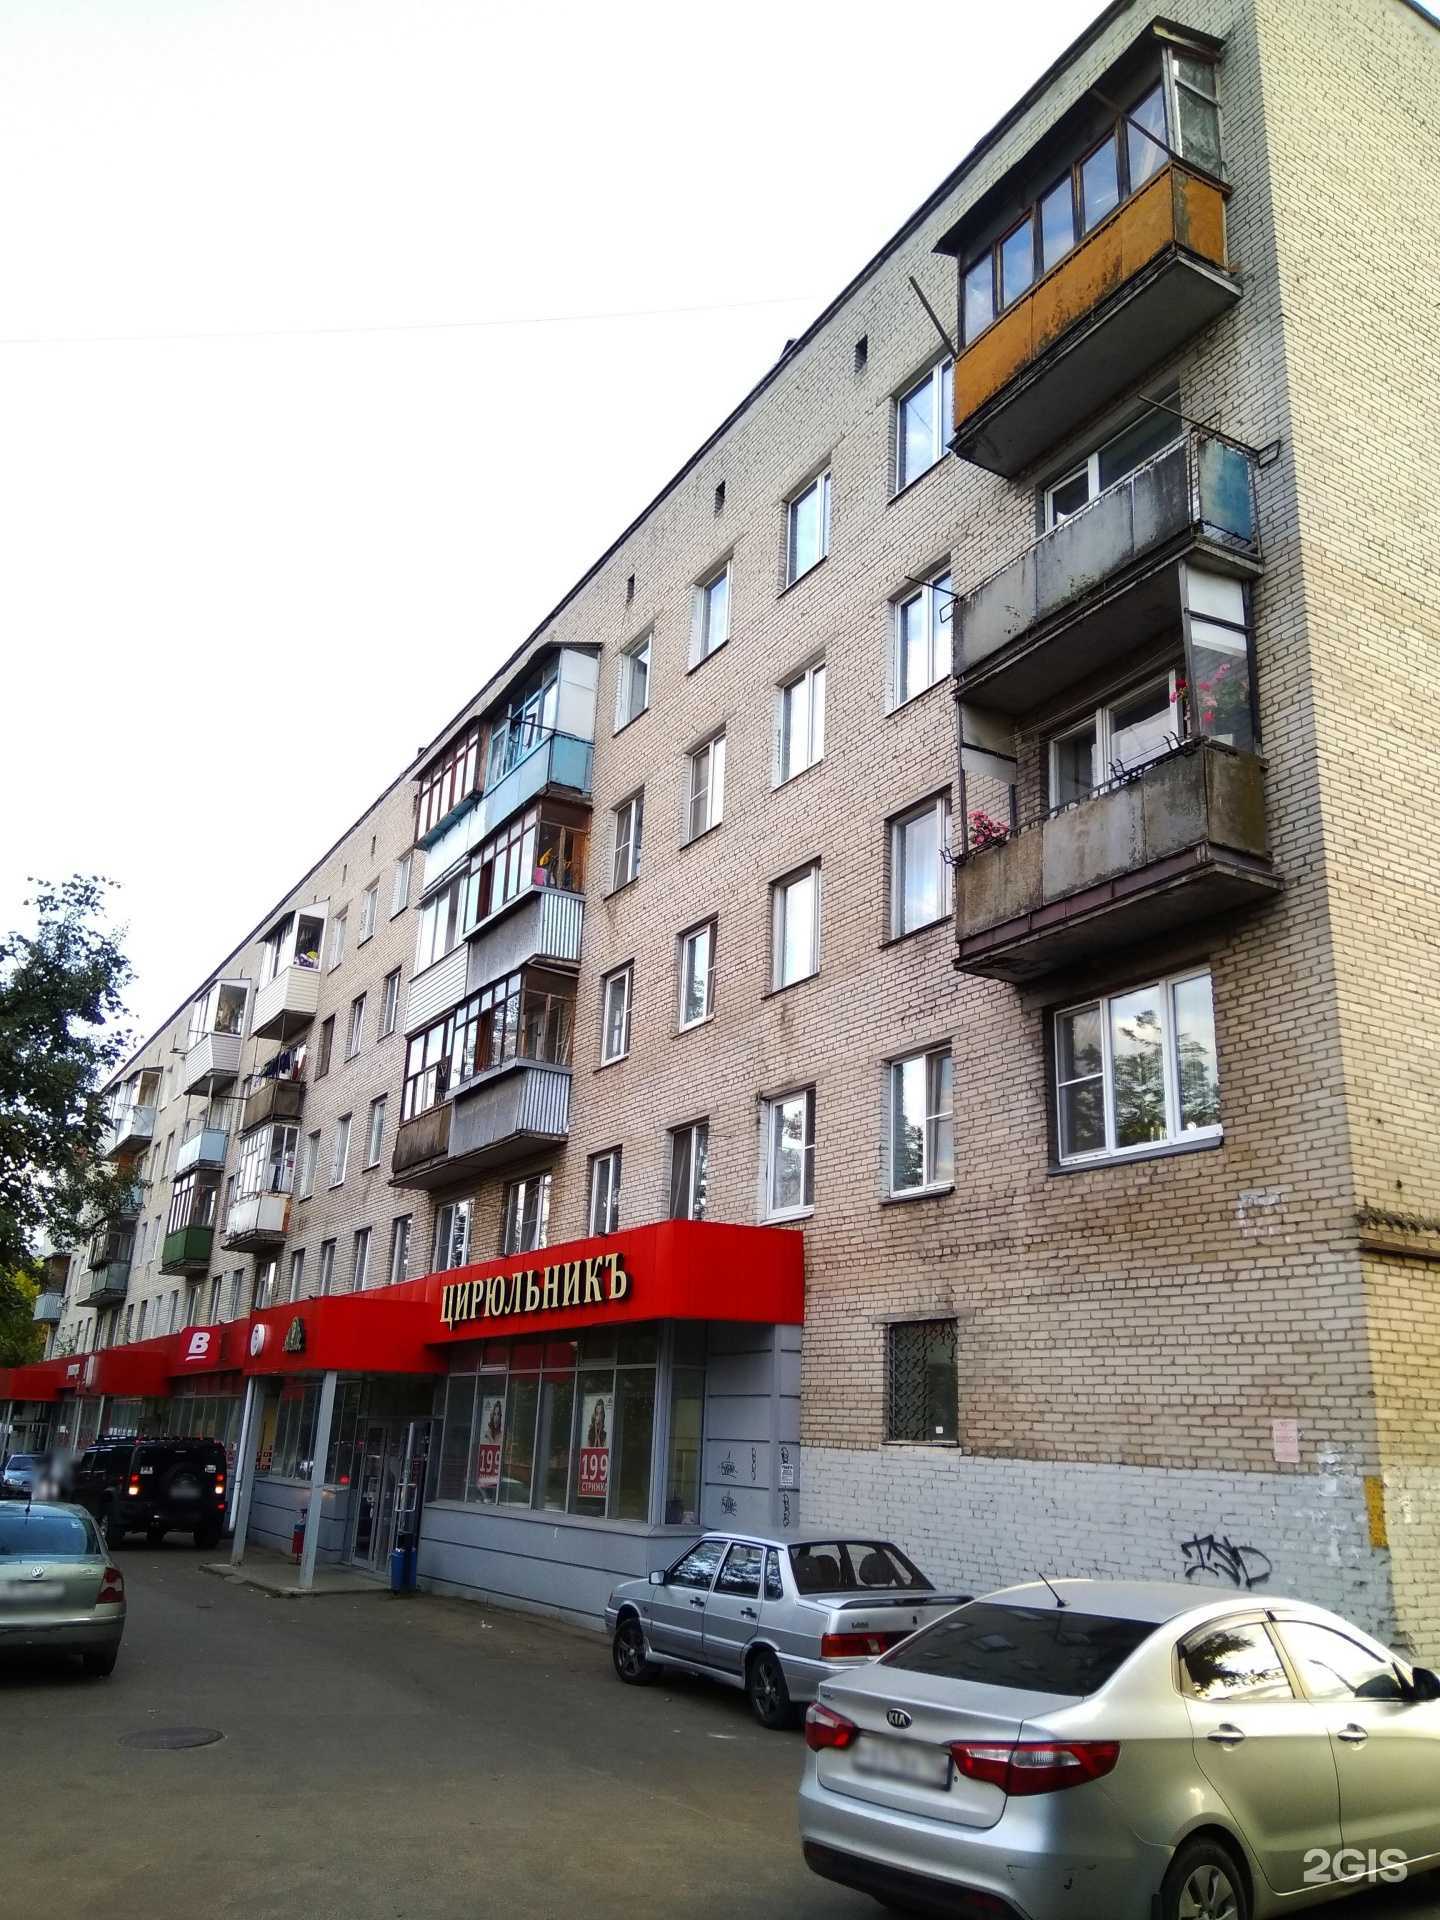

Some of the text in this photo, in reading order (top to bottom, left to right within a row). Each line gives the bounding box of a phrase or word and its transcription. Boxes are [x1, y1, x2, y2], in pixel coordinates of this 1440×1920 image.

[440, 1253, 627, 1331] ЦИРЮЛЬНИКЪ
[581, 1454, 608, 1481] 199
[887, 1711, 908, 1727] KIA
